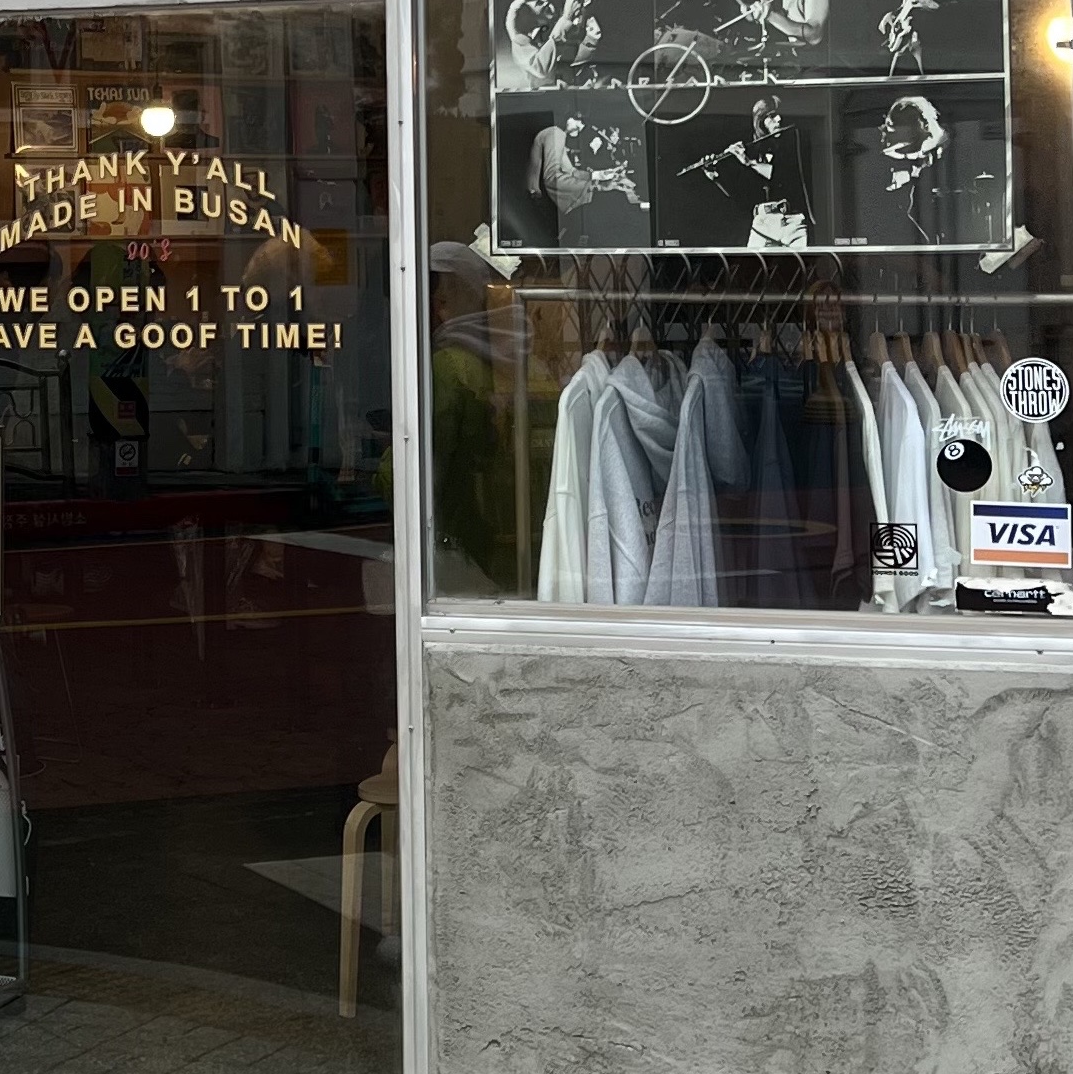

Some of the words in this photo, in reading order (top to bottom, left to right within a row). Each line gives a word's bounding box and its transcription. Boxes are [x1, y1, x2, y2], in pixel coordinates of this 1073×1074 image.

[24, 150, 148, 201] THANK
[166, 151, 277, 200] Y'ALL
[0, 194, 97, 253] MADE
[119, 188, 152, 212] IN
[175, 188, 302, 249] BUSAN
[68, 286, 166, 312] OPEN
[186, 286, 200, 312] 1
[222, 286, 269, 311] TO
[289, 285, 303, 311] 1
[75, 323, 98, 349] A
[114, 323, 218, 349] GOOF
[237, 323, 342, 349] TIME!
[1007, 366, 1061, 391] STONES
[1009, 391, 1060, 415] THROW
[948, 444, 961, 457] 8
[988, 522, 1056, 546] VISA
